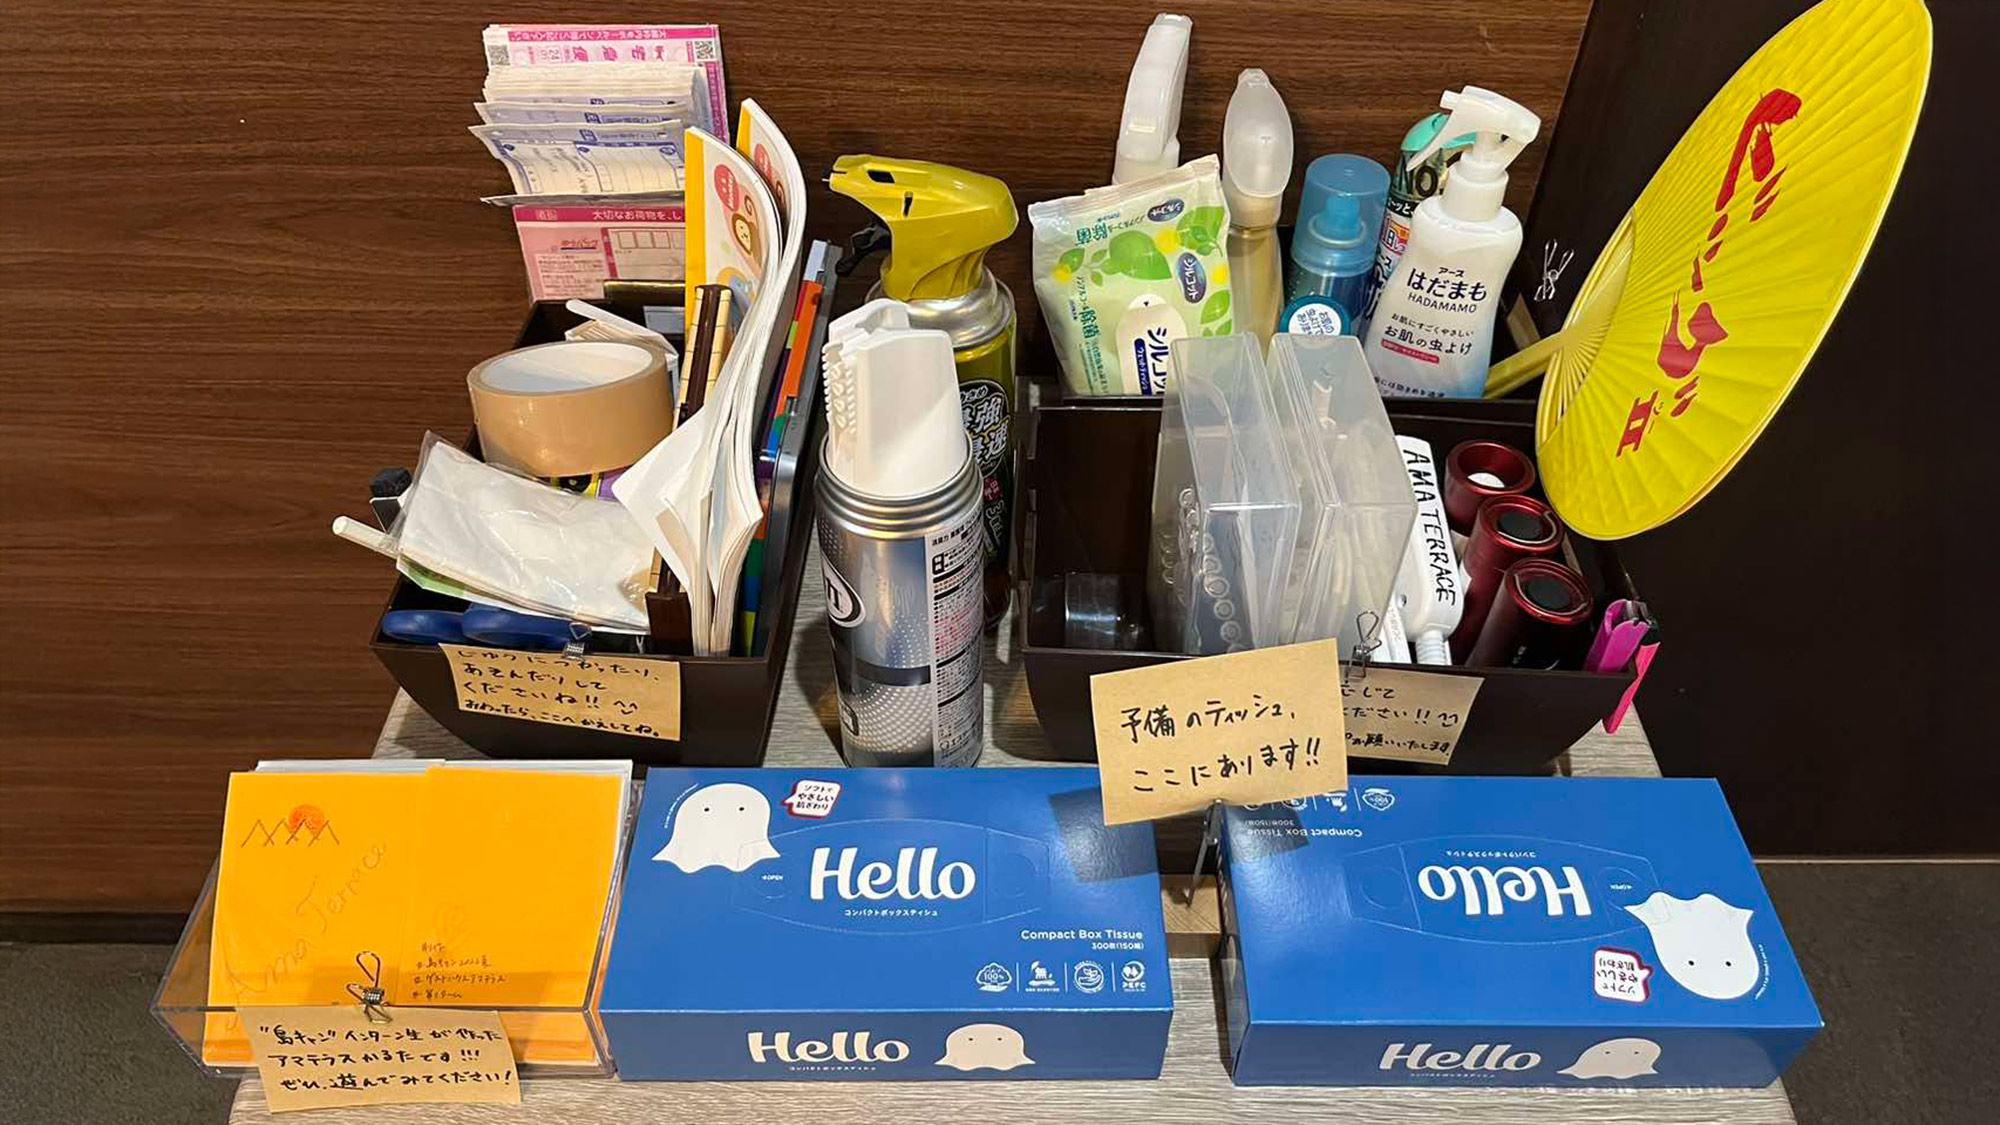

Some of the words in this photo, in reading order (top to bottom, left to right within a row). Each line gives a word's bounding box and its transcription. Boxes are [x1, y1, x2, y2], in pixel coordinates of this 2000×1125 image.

[1183, 258, 1199, 300] シルコット
[1406, 267, 1488, 302] はだまも
[1438, 266, 1465, 278] アース
[1407, 292, 1477, 314] HADAMAMO
[1391, 312, 1475, 337] お肌にすごくやさしい
[1384, 325, 1473, 356] お肌の虫よけ
[1403, 448, 1436, 503] AMA
[1420, 508, 1456, 607] TERRACE
[1247, 829, 1283, 837] Tissue
[1286, 828, 1308, 837] Box
[1311, 828, 1363, 838] Compact
[810, 846, 977, 901] Hello
[1417, 864, 1592, 916] Hello
[1020, 928, 1076, 942] Compact
[1079, 929, 1104, 940] Box
[1107, 928, 1144, 940] Tissue
[1596, 969, 1638, 983] やさしい
[747, 1031, 910, 1064] Hello
[1378, 1042, 1541, 1072] Hello
